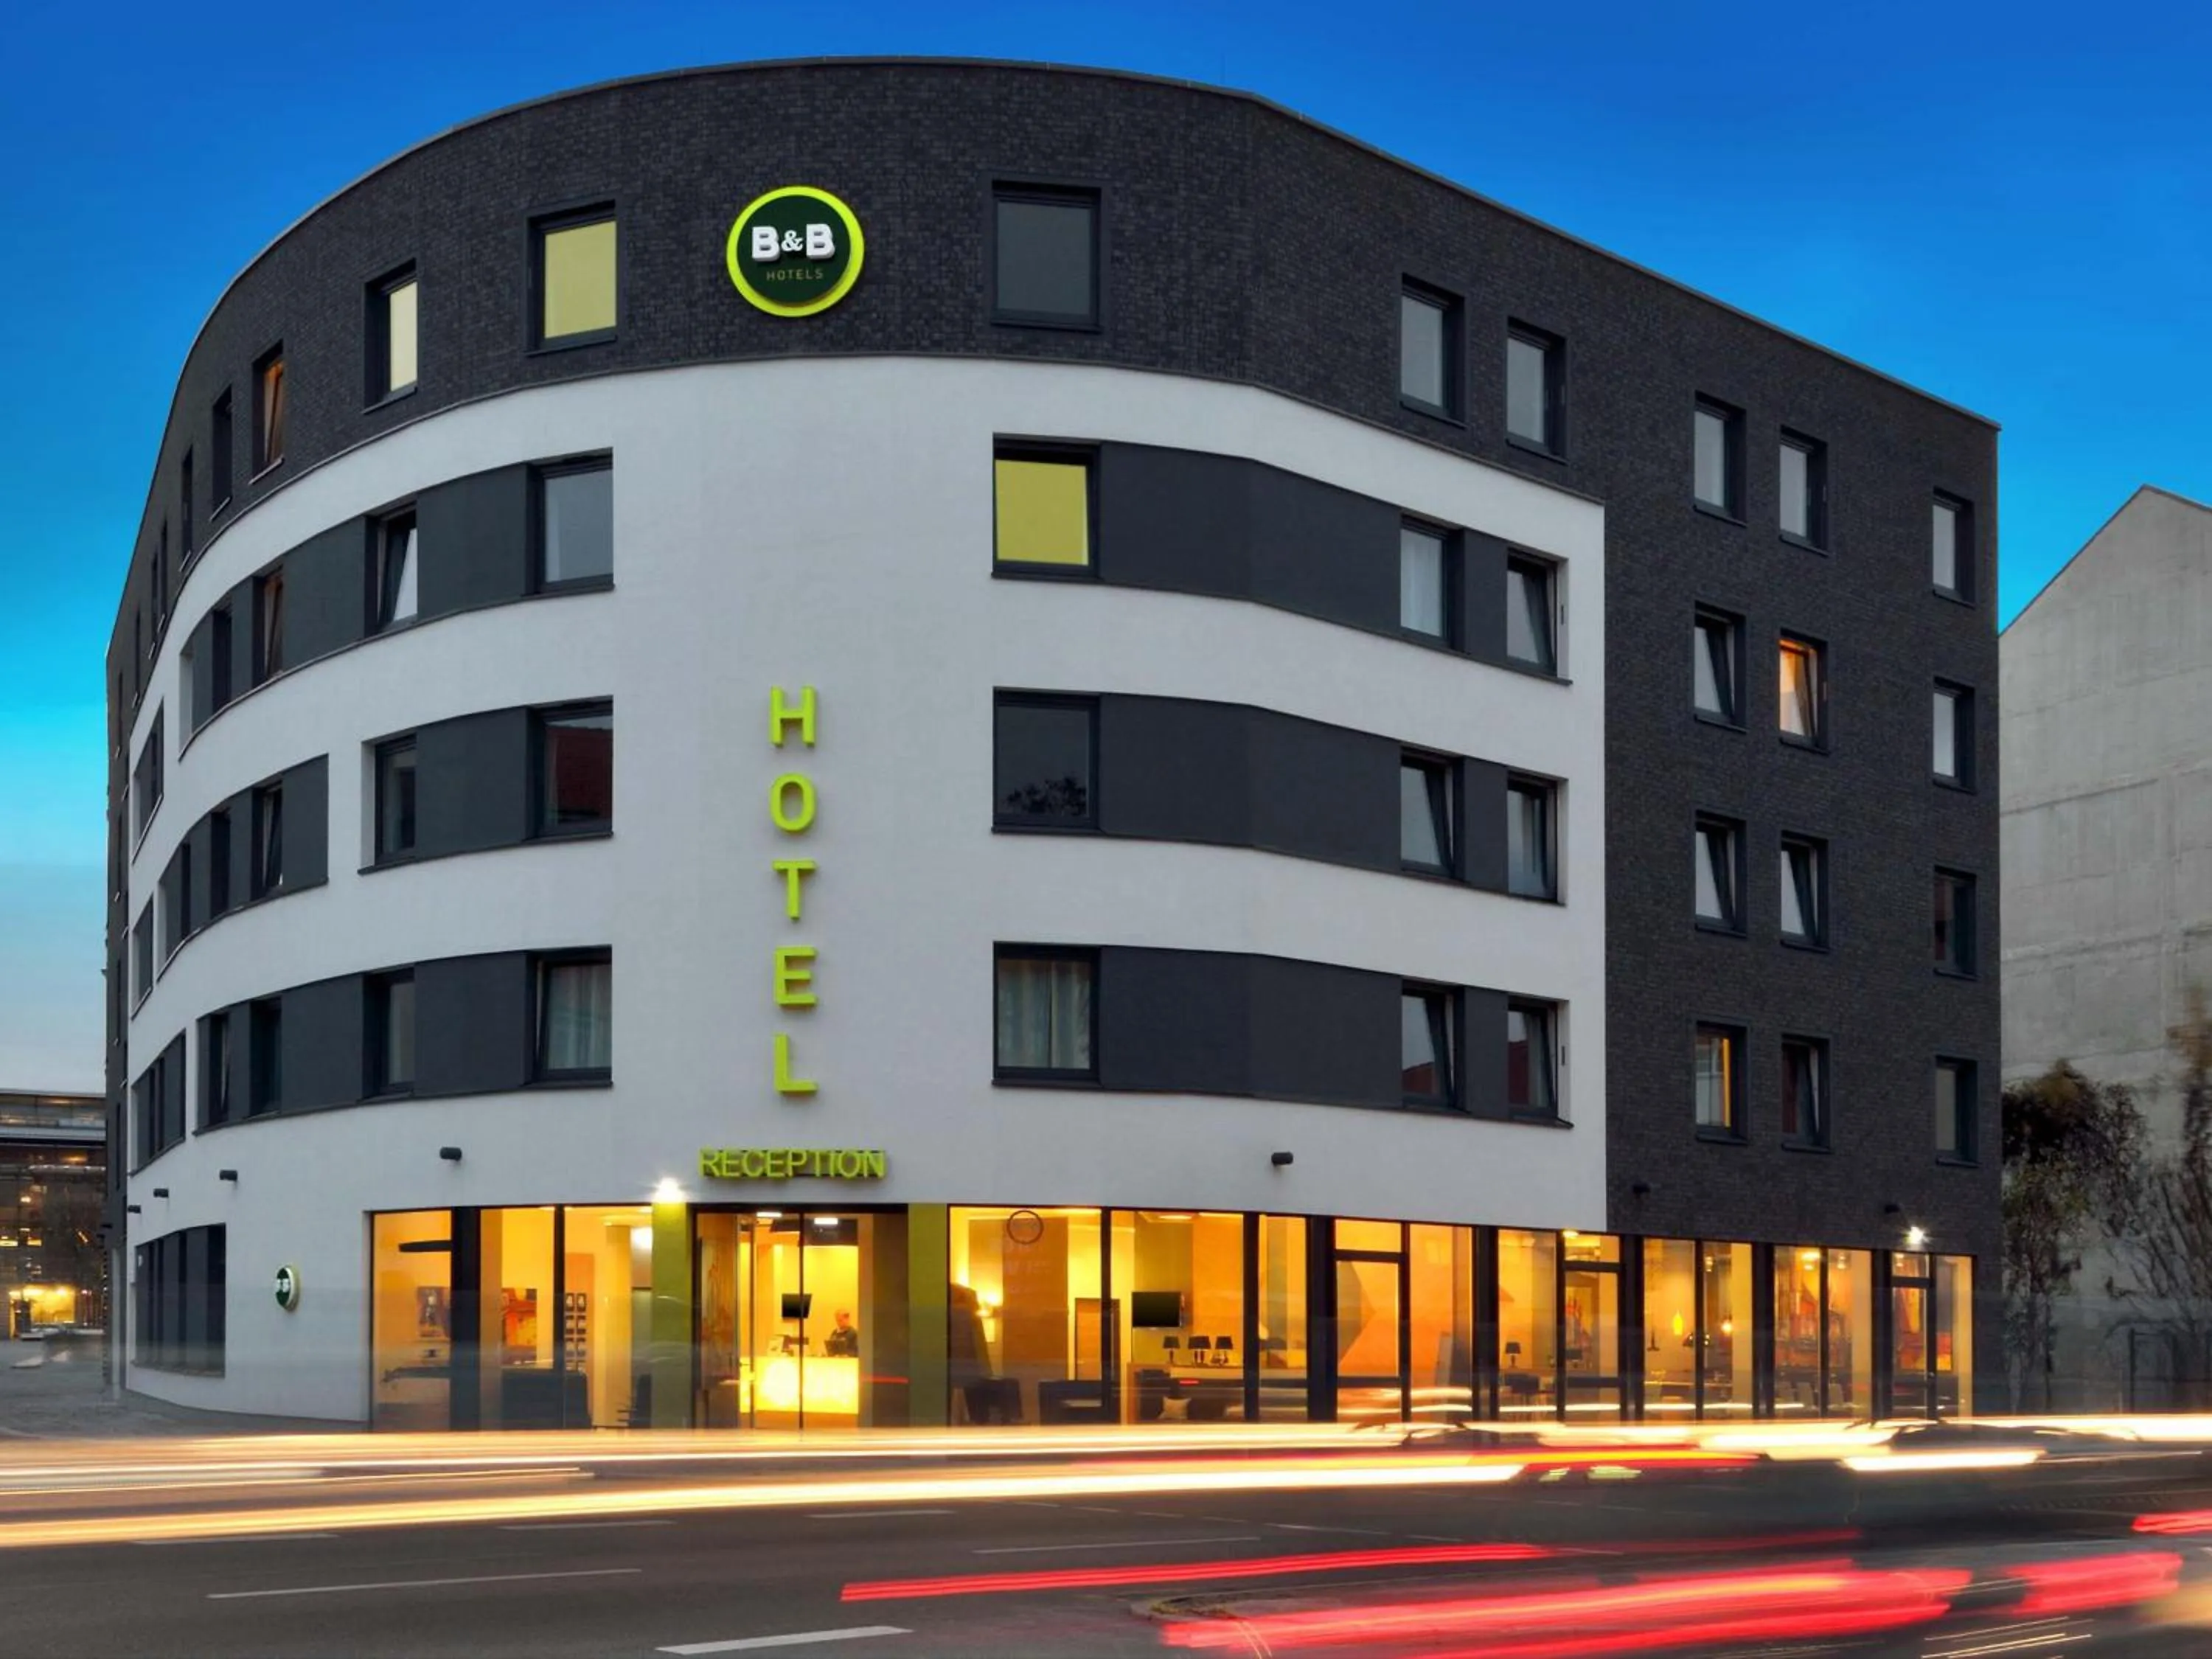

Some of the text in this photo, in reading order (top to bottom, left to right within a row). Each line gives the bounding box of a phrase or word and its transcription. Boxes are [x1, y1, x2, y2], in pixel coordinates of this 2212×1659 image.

[751, 223, 835, 261] B&B
[765, 268, 824, 281] HOTELS
[769, 686, 818, 1093] HOTEL
[700, 1149, 886, 1180] RECEPTION
